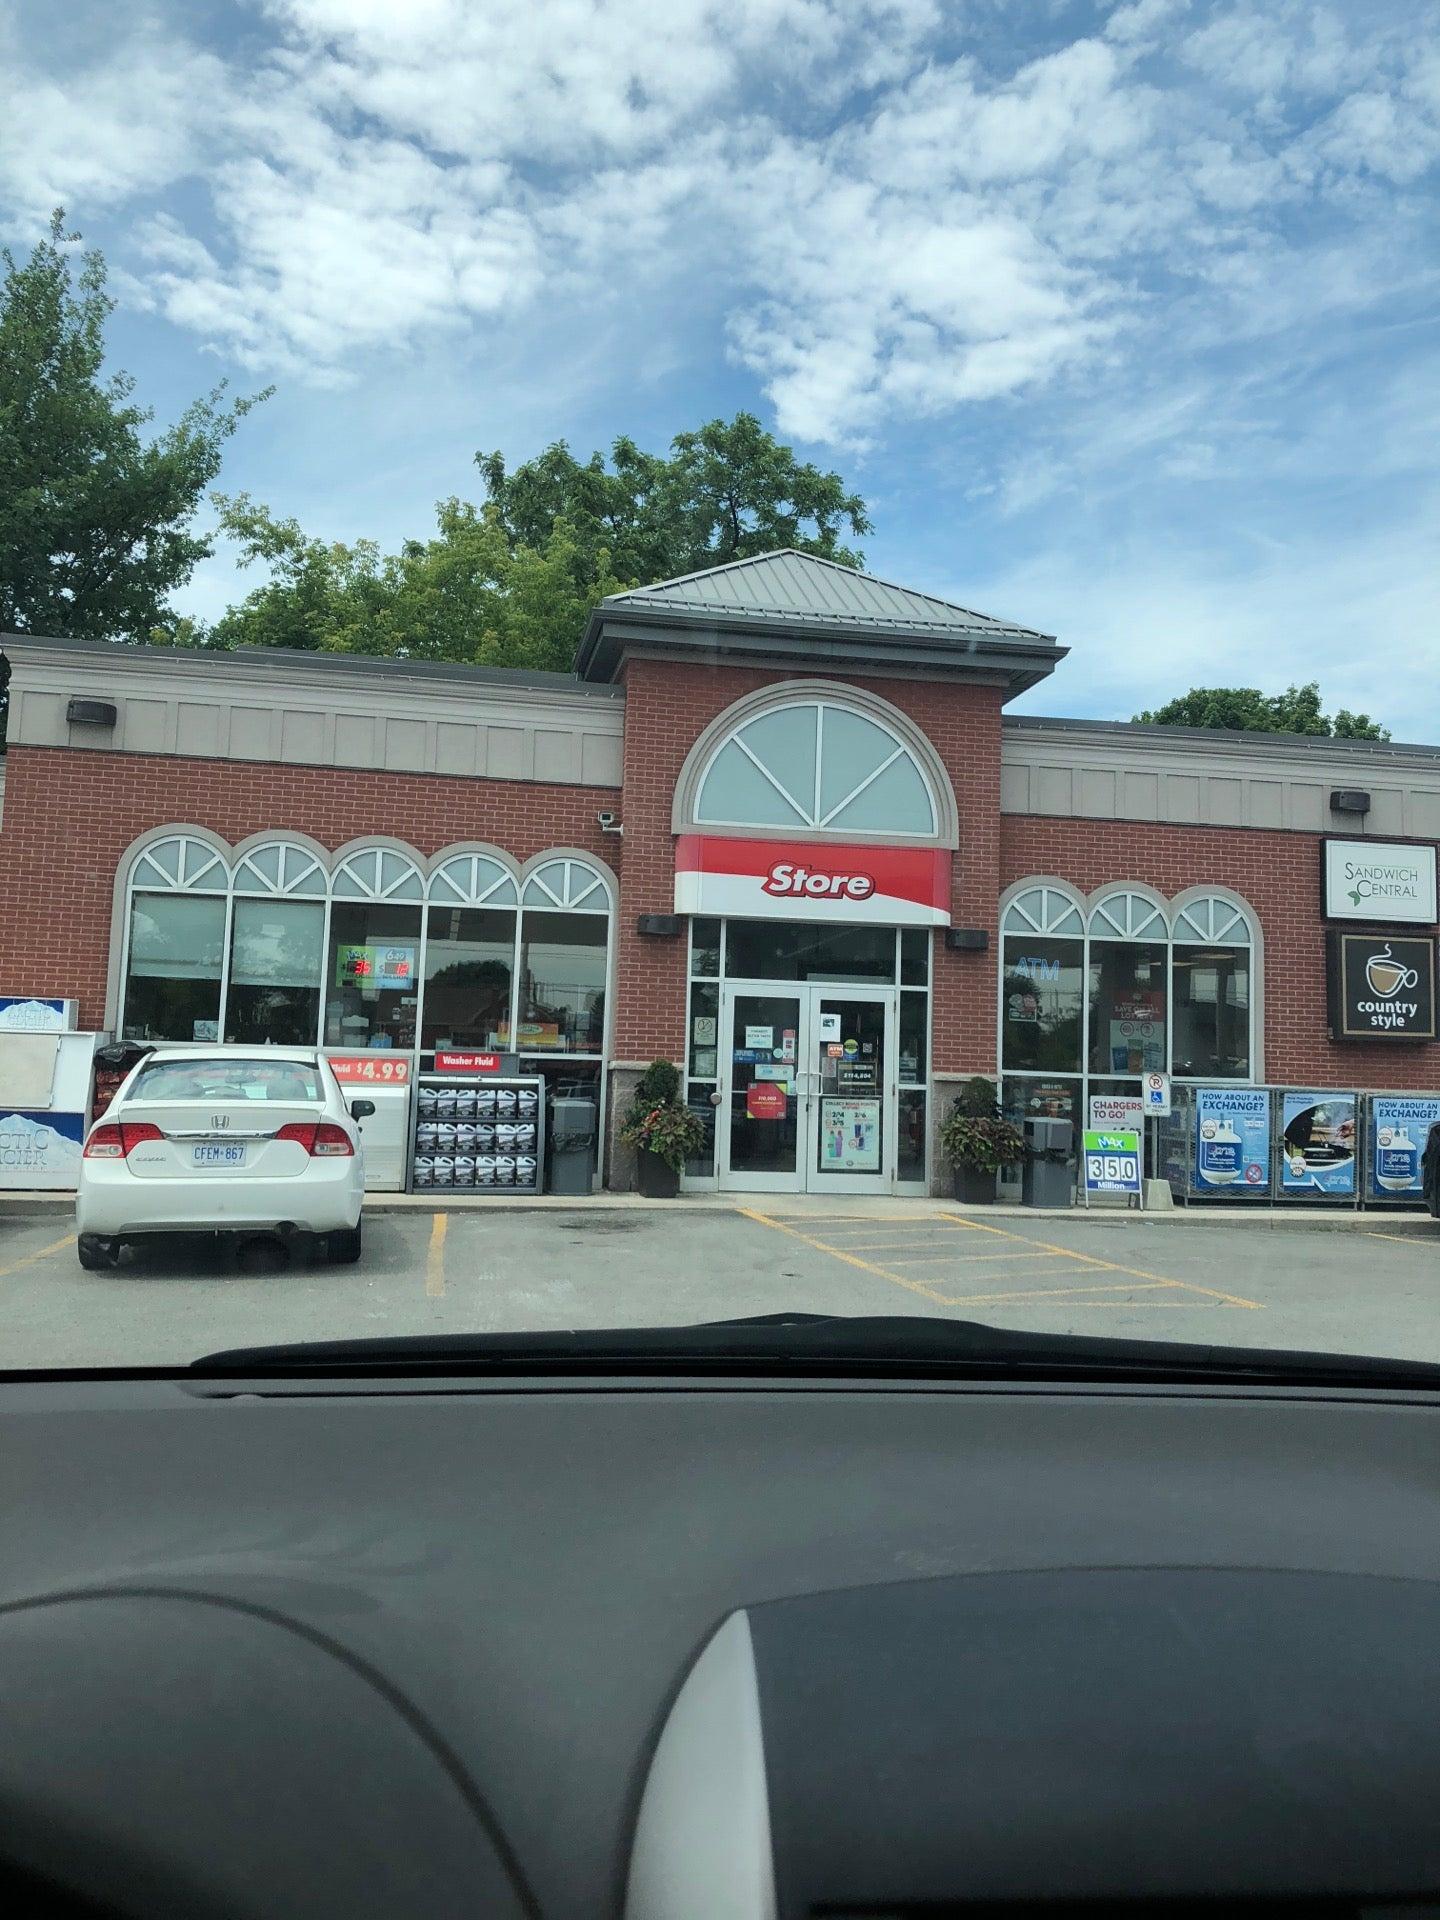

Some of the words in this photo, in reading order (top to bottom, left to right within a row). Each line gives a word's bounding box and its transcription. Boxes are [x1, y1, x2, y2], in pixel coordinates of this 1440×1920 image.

[768, 864, 871, 896] Store
[1014, 956, 1061, 981] ATM
[1357, 1001, 1418, 1017] country
[1370, 1013, 1406, 1029] style
[442, 1055, 472, 1066] Washer
[474, 1055, 494, 1067] Fluid
[356, 1062, 407, 1080] $4.99
[1093, 1101, 1143, 1111] CHARGERS
[1202, 1101, 1265, 1111] EXCHANGE?
[1378, 1101, 1398, 1109] HOW
[1093, 1110, 1107, 1119] TO
[1108, 1110, 1126, 1119] GO!
[1378, 1109, 1438, 1119] EXCHANGE?
[194, 1147, 220, 1160] CFEM
[225, 1147, 245, 1160] 867
[1097, 1181, 1126, 1190] Million
